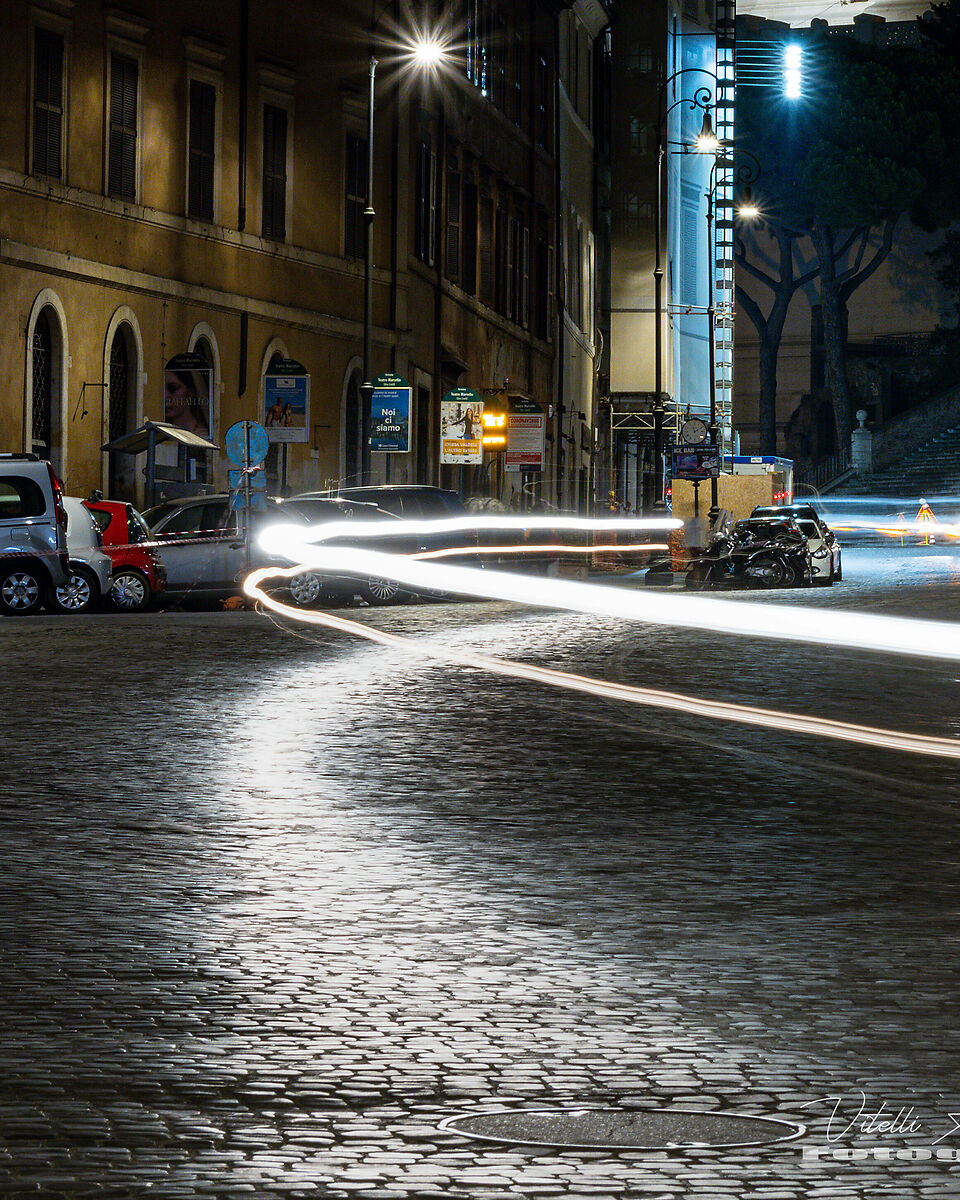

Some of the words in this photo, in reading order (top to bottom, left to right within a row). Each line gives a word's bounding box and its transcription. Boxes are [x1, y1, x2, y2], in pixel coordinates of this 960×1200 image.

[381, 408, 396, 416] Noi
[385, 415, 392, 424] ci
[376, 423, 401, 432] siamo
